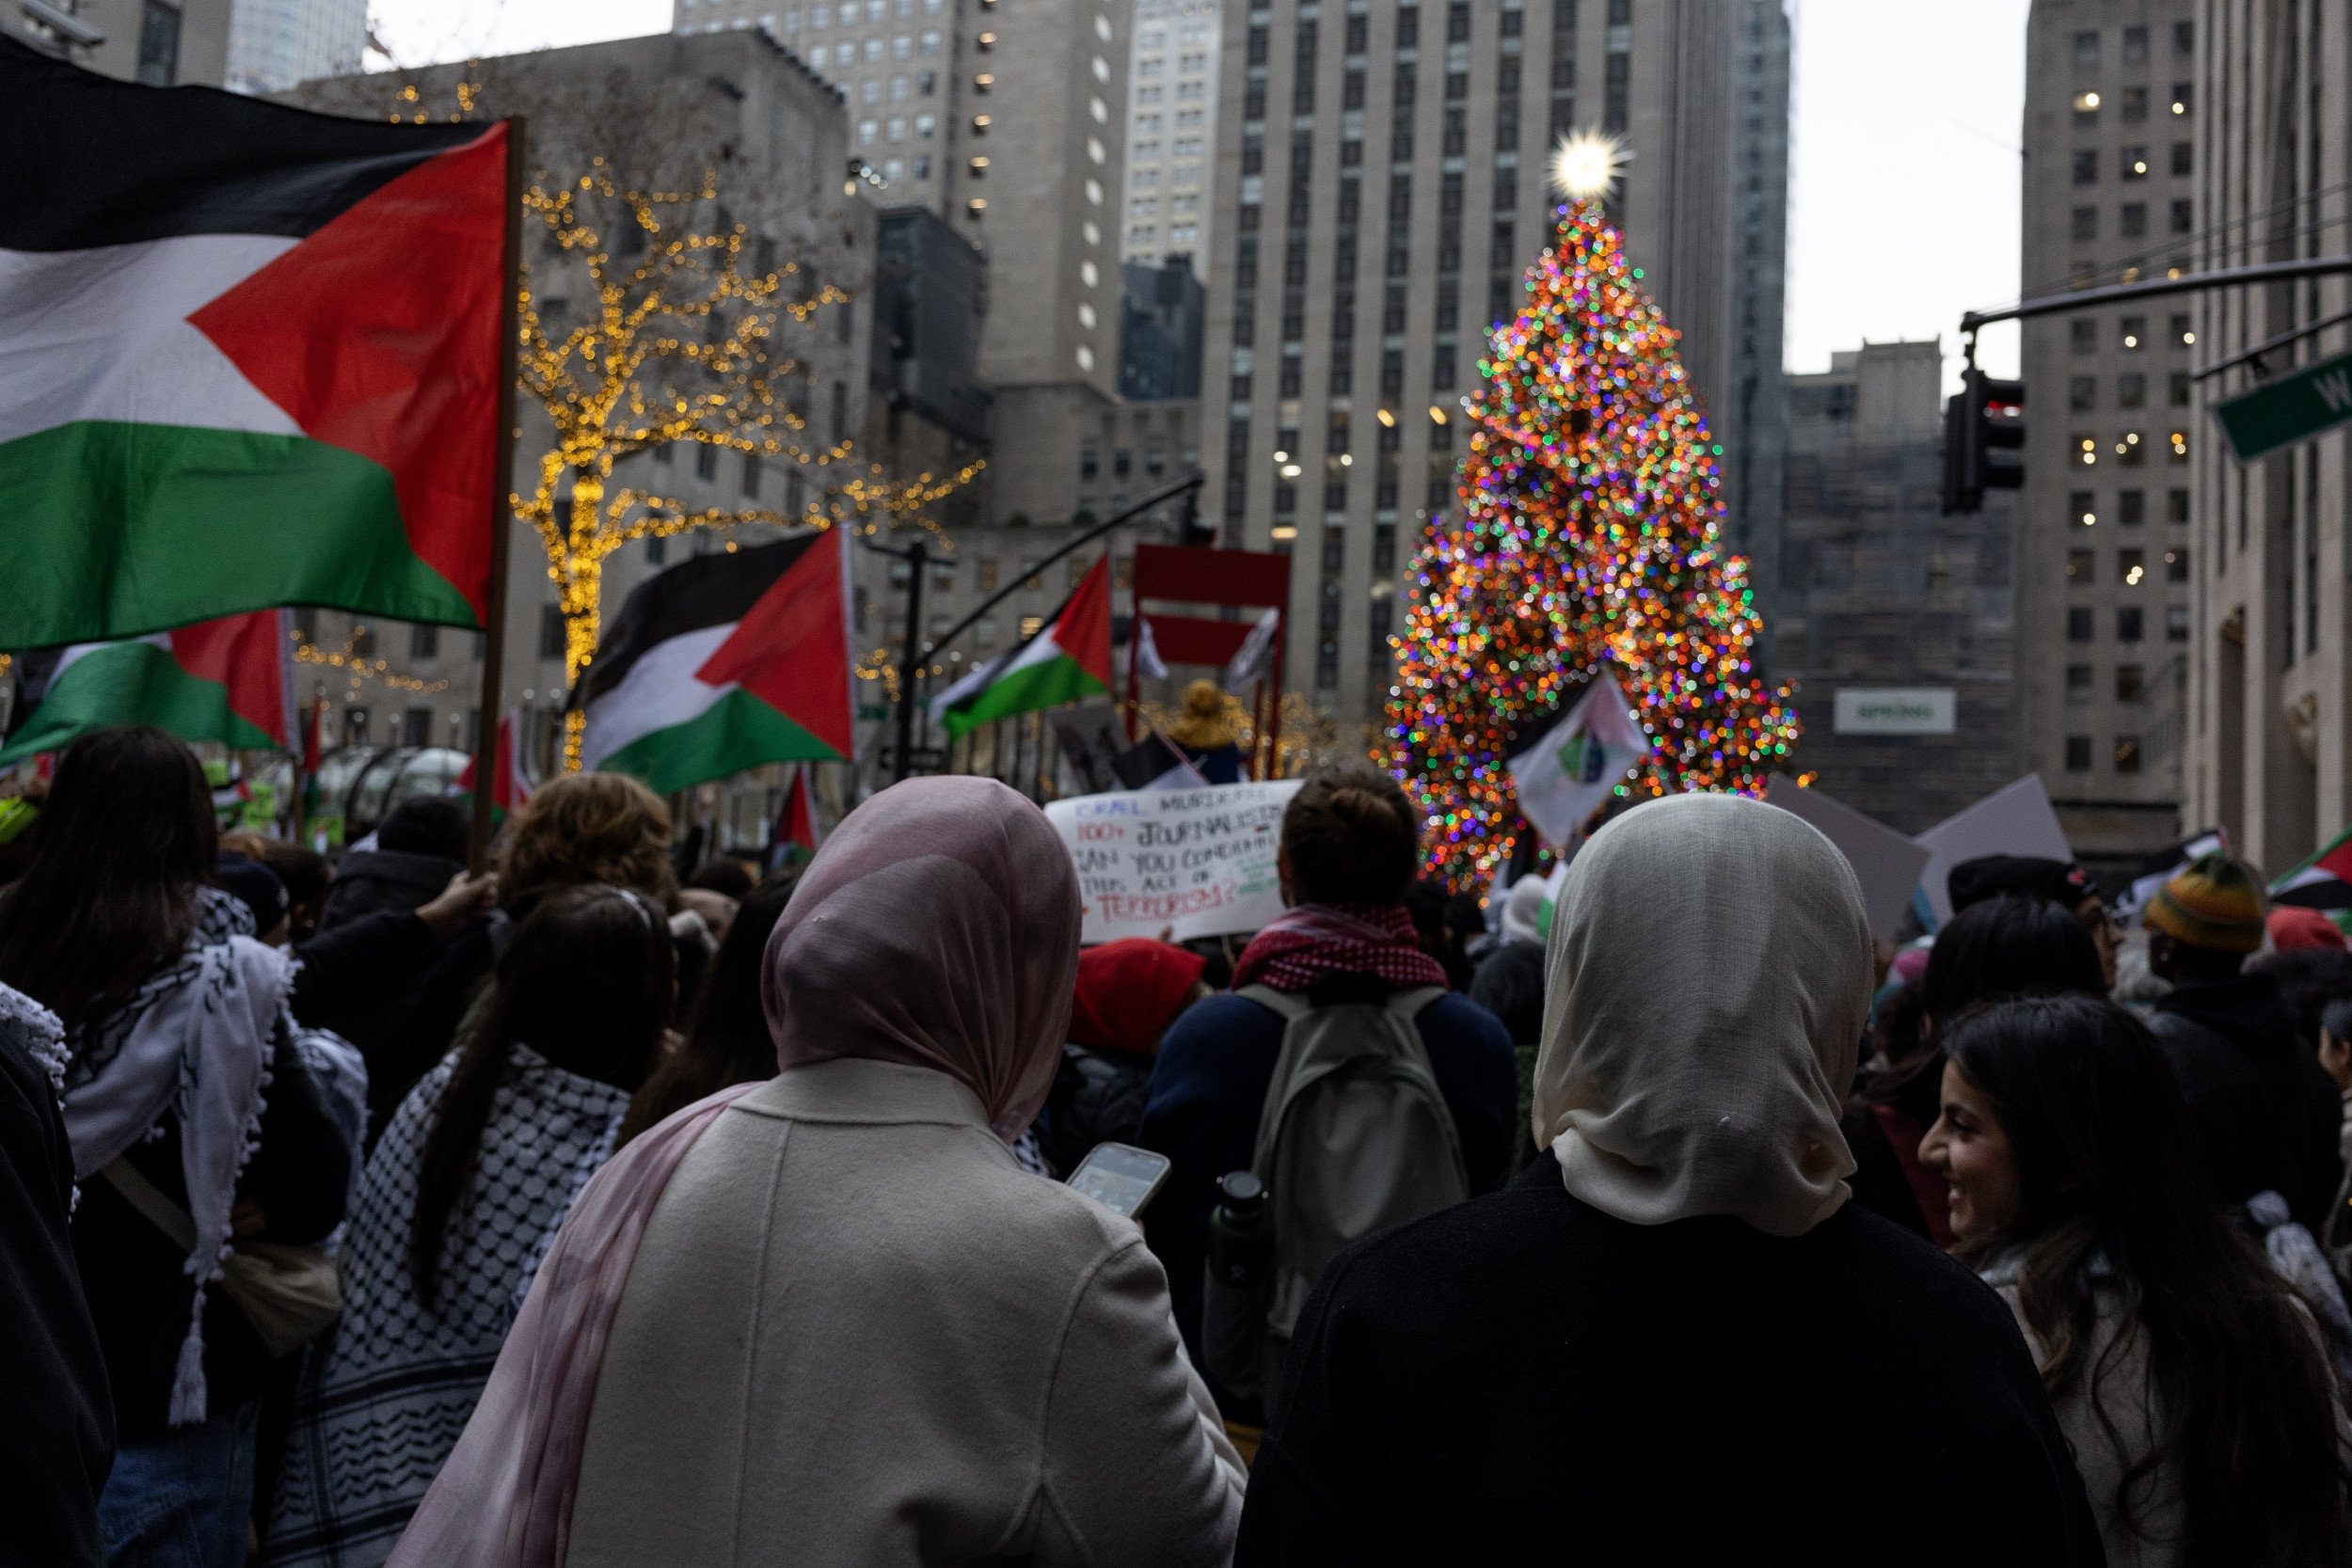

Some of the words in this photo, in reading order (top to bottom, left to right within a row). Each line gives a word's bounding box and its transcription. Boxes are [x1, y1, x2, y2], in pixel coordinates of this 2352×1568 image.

[2312, 368, 2352, 413] W
[1129, 850, 1176, 877] YOU
[1082, 875, 1129, 896] THIS
[1140, 873, 1178, 895] ACT
